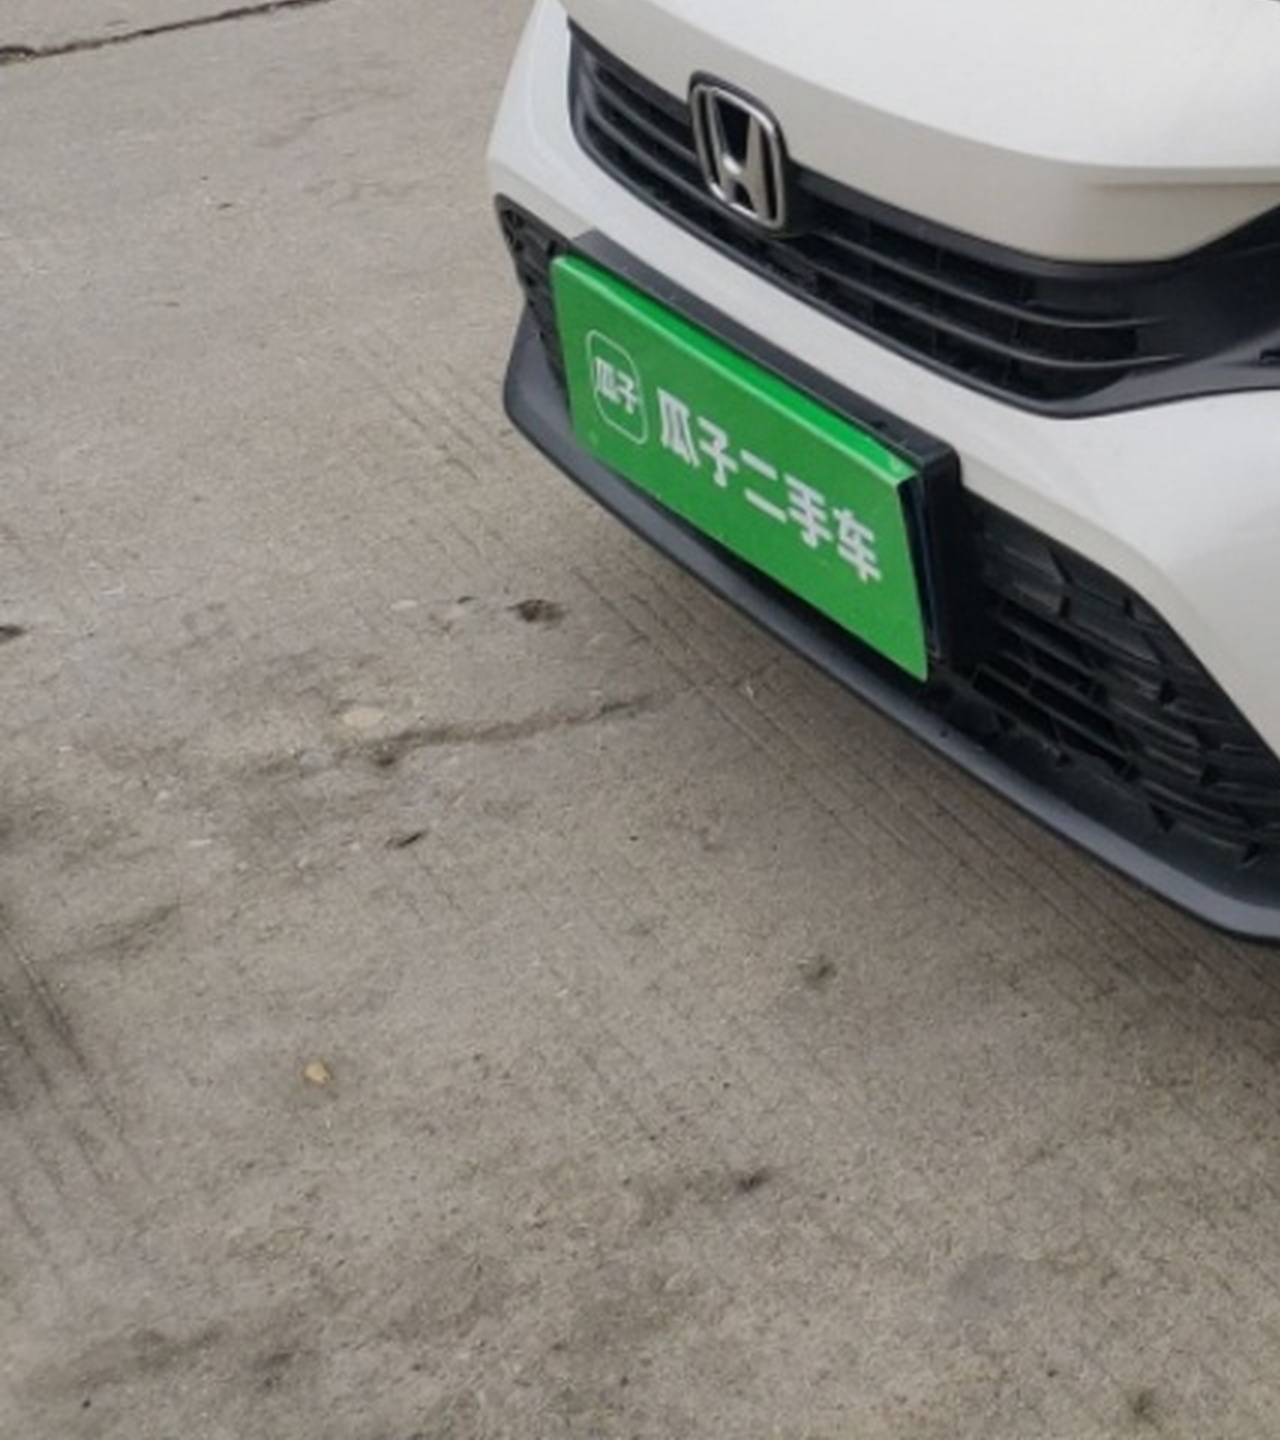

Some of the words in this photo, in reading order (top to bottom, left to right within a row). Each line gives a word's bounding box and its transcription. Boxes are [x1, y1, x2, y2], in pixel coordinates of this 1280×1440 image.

[595, 357, 637, 415] 瓜子
[657, 387, 882, 583] 瓜子二手车
